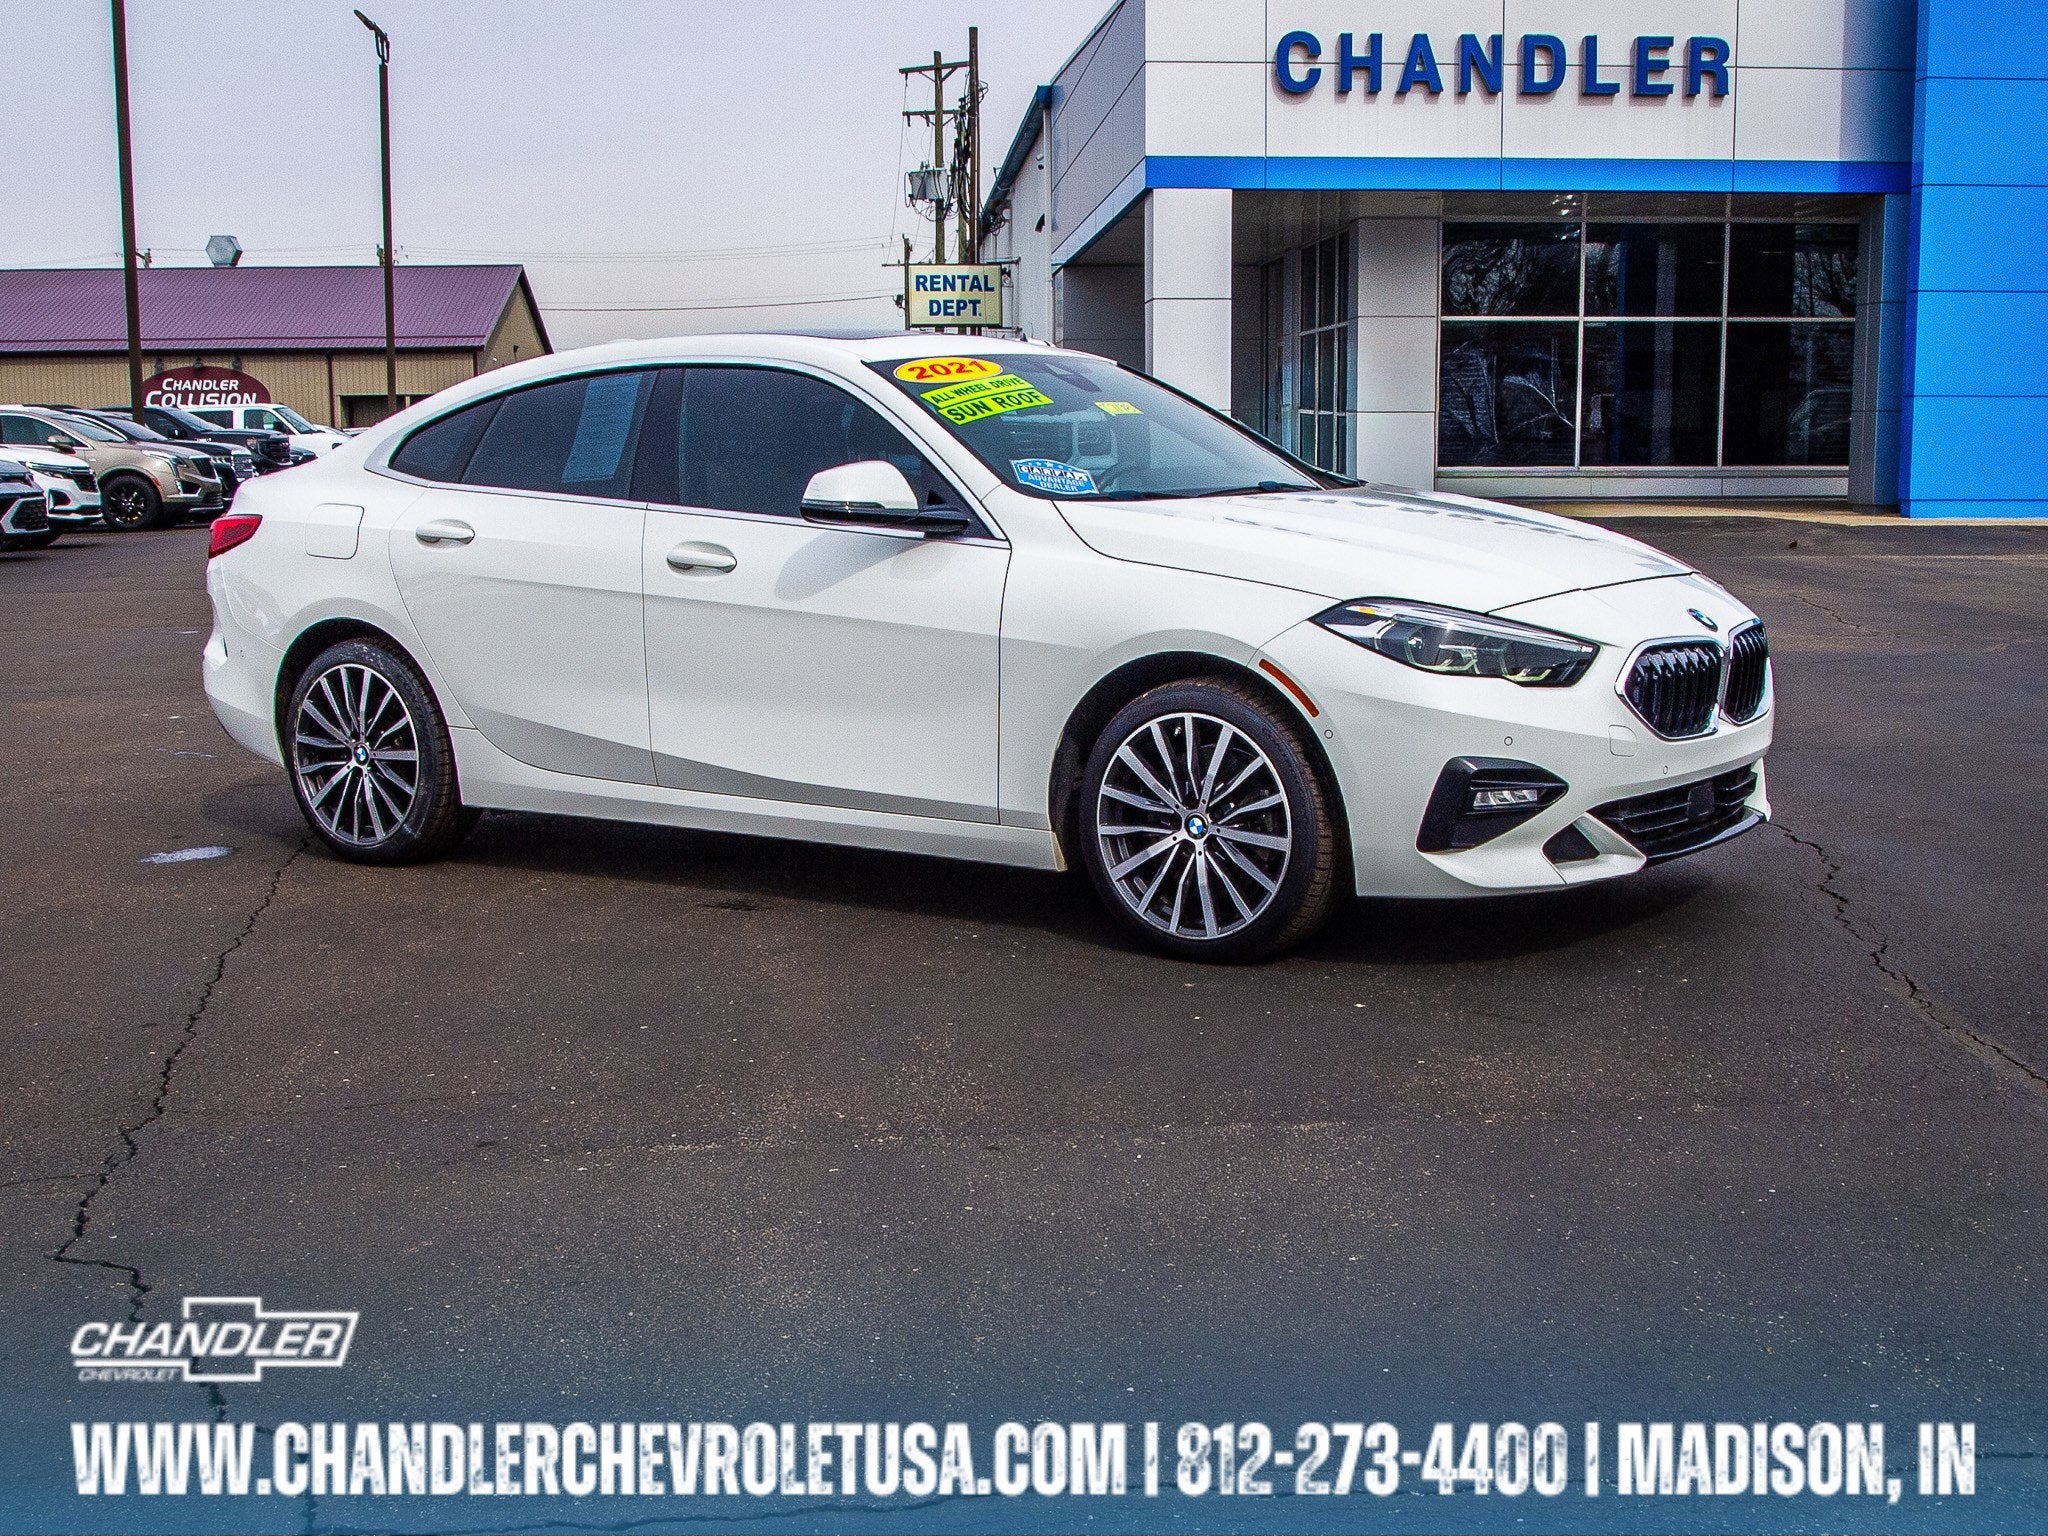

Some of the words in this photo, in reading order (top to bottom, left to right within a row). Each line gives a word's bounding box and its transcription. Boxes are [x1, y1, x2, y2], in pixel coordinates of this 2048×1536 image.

[1274, 31, 1731, 97] CHANDLER
[915, 274, 995, 292] RENTAL
[929, 299, 982, 316] DEPT.
[908, 360, 988, 380] 2021
[162, 378, 240, 391] CHANDLER
[930, 391, 956, 404] ALL
[955, 384, 991, 399] WHEEL
[994, 376, 1026, 390] DRIVE
[145, 391, 257, 408] COLLISION
[946, 400, 991, 422] SUN
[991, 391, 1044, 411] ROOF
[1027, 474, 1086, 487] ADVANTAGE
[1039, 481, 1079, 492] DEALER
